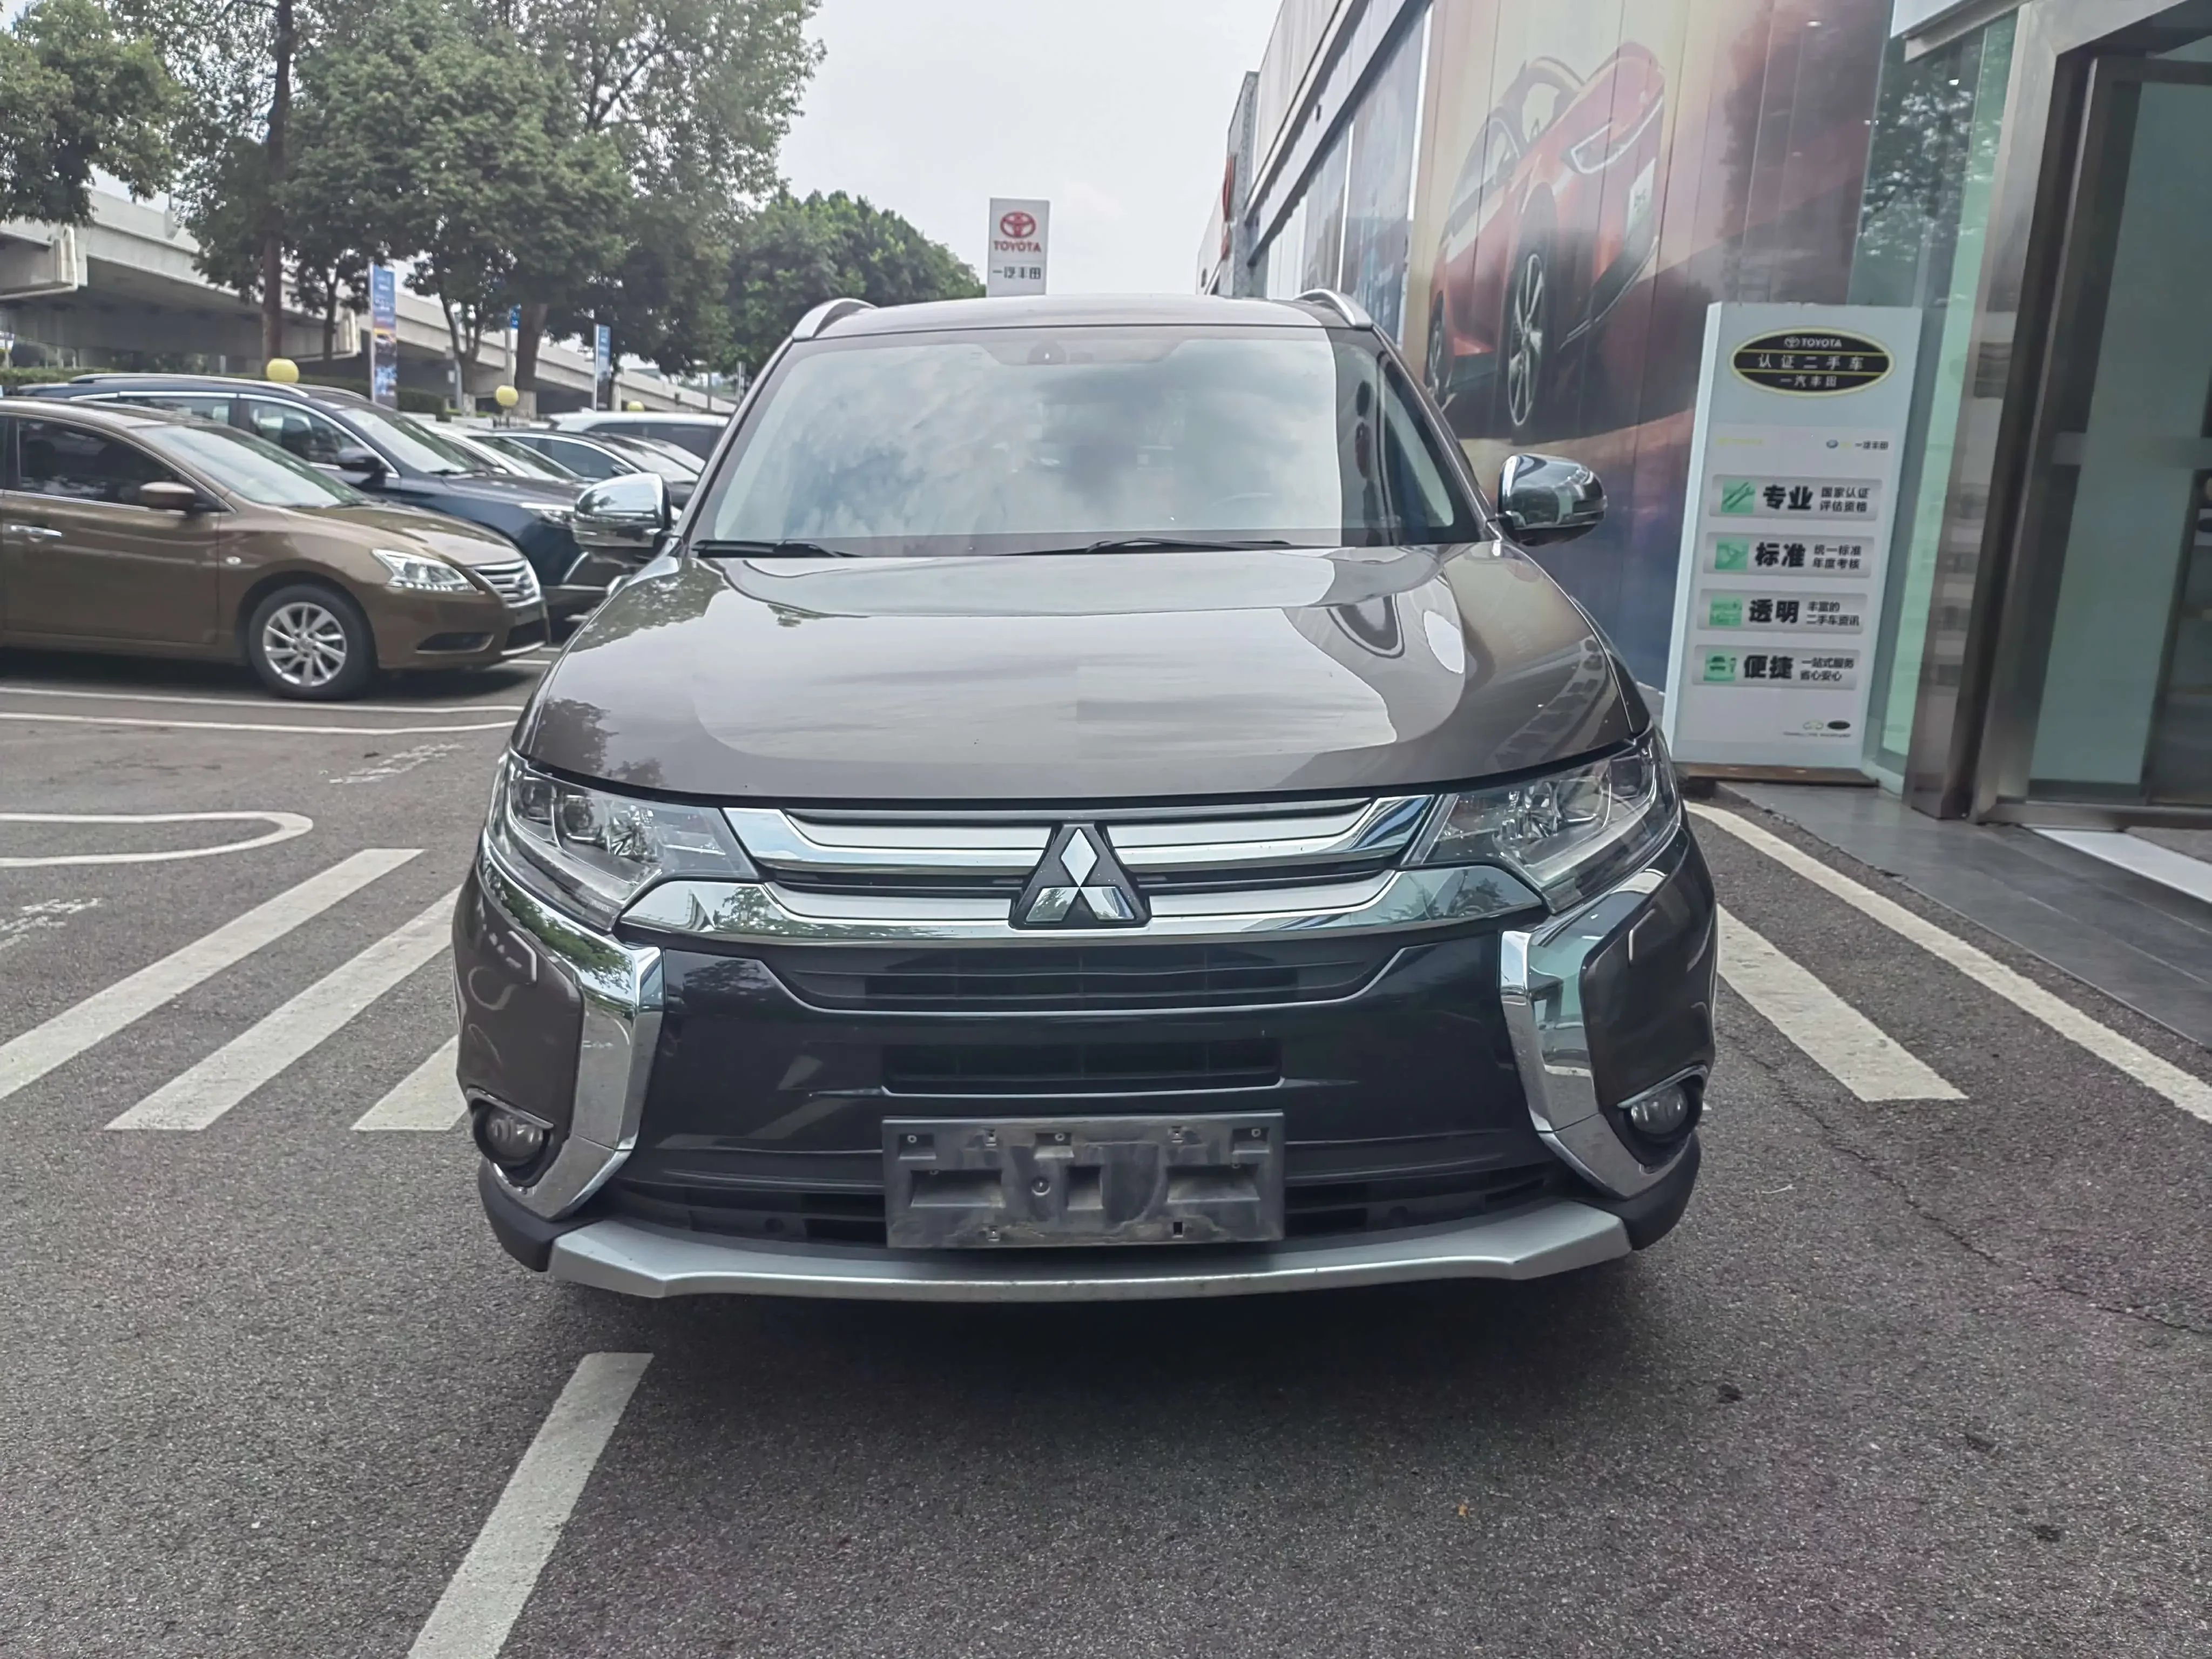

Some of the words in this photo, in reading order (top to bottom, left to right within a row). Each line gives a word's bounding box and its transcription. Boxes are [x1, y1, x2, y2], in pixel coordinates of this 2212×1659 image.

[993, 240, 1041, 253] TOYOTA
[1801, 337, 1842, 347] TOYOTA
[1758, 353, 1863, 370] 认证二手车
[1780, 374, 1837, 387] 一汽丰田
[1763, 484, 1813, 510] 专业
[1820, 487, 1870, 499] 国家认证
[1819, 500, 1868, 512] 评估资格
[1755, 542, 1806, 568] 标准
[1814, 544, 1862, 556] 统一标准
[1812, 557, 1860, 569] 年度考核
[1749, 598, 1800, 624] 透明
[1807, 601, 1840, 612] 丰富的
[1806, 613, 1860, 626] 二手车资讯
[1744, 655, 1794, 679] 便捷
[1802, 657, 1854, 669] 一站式服务
